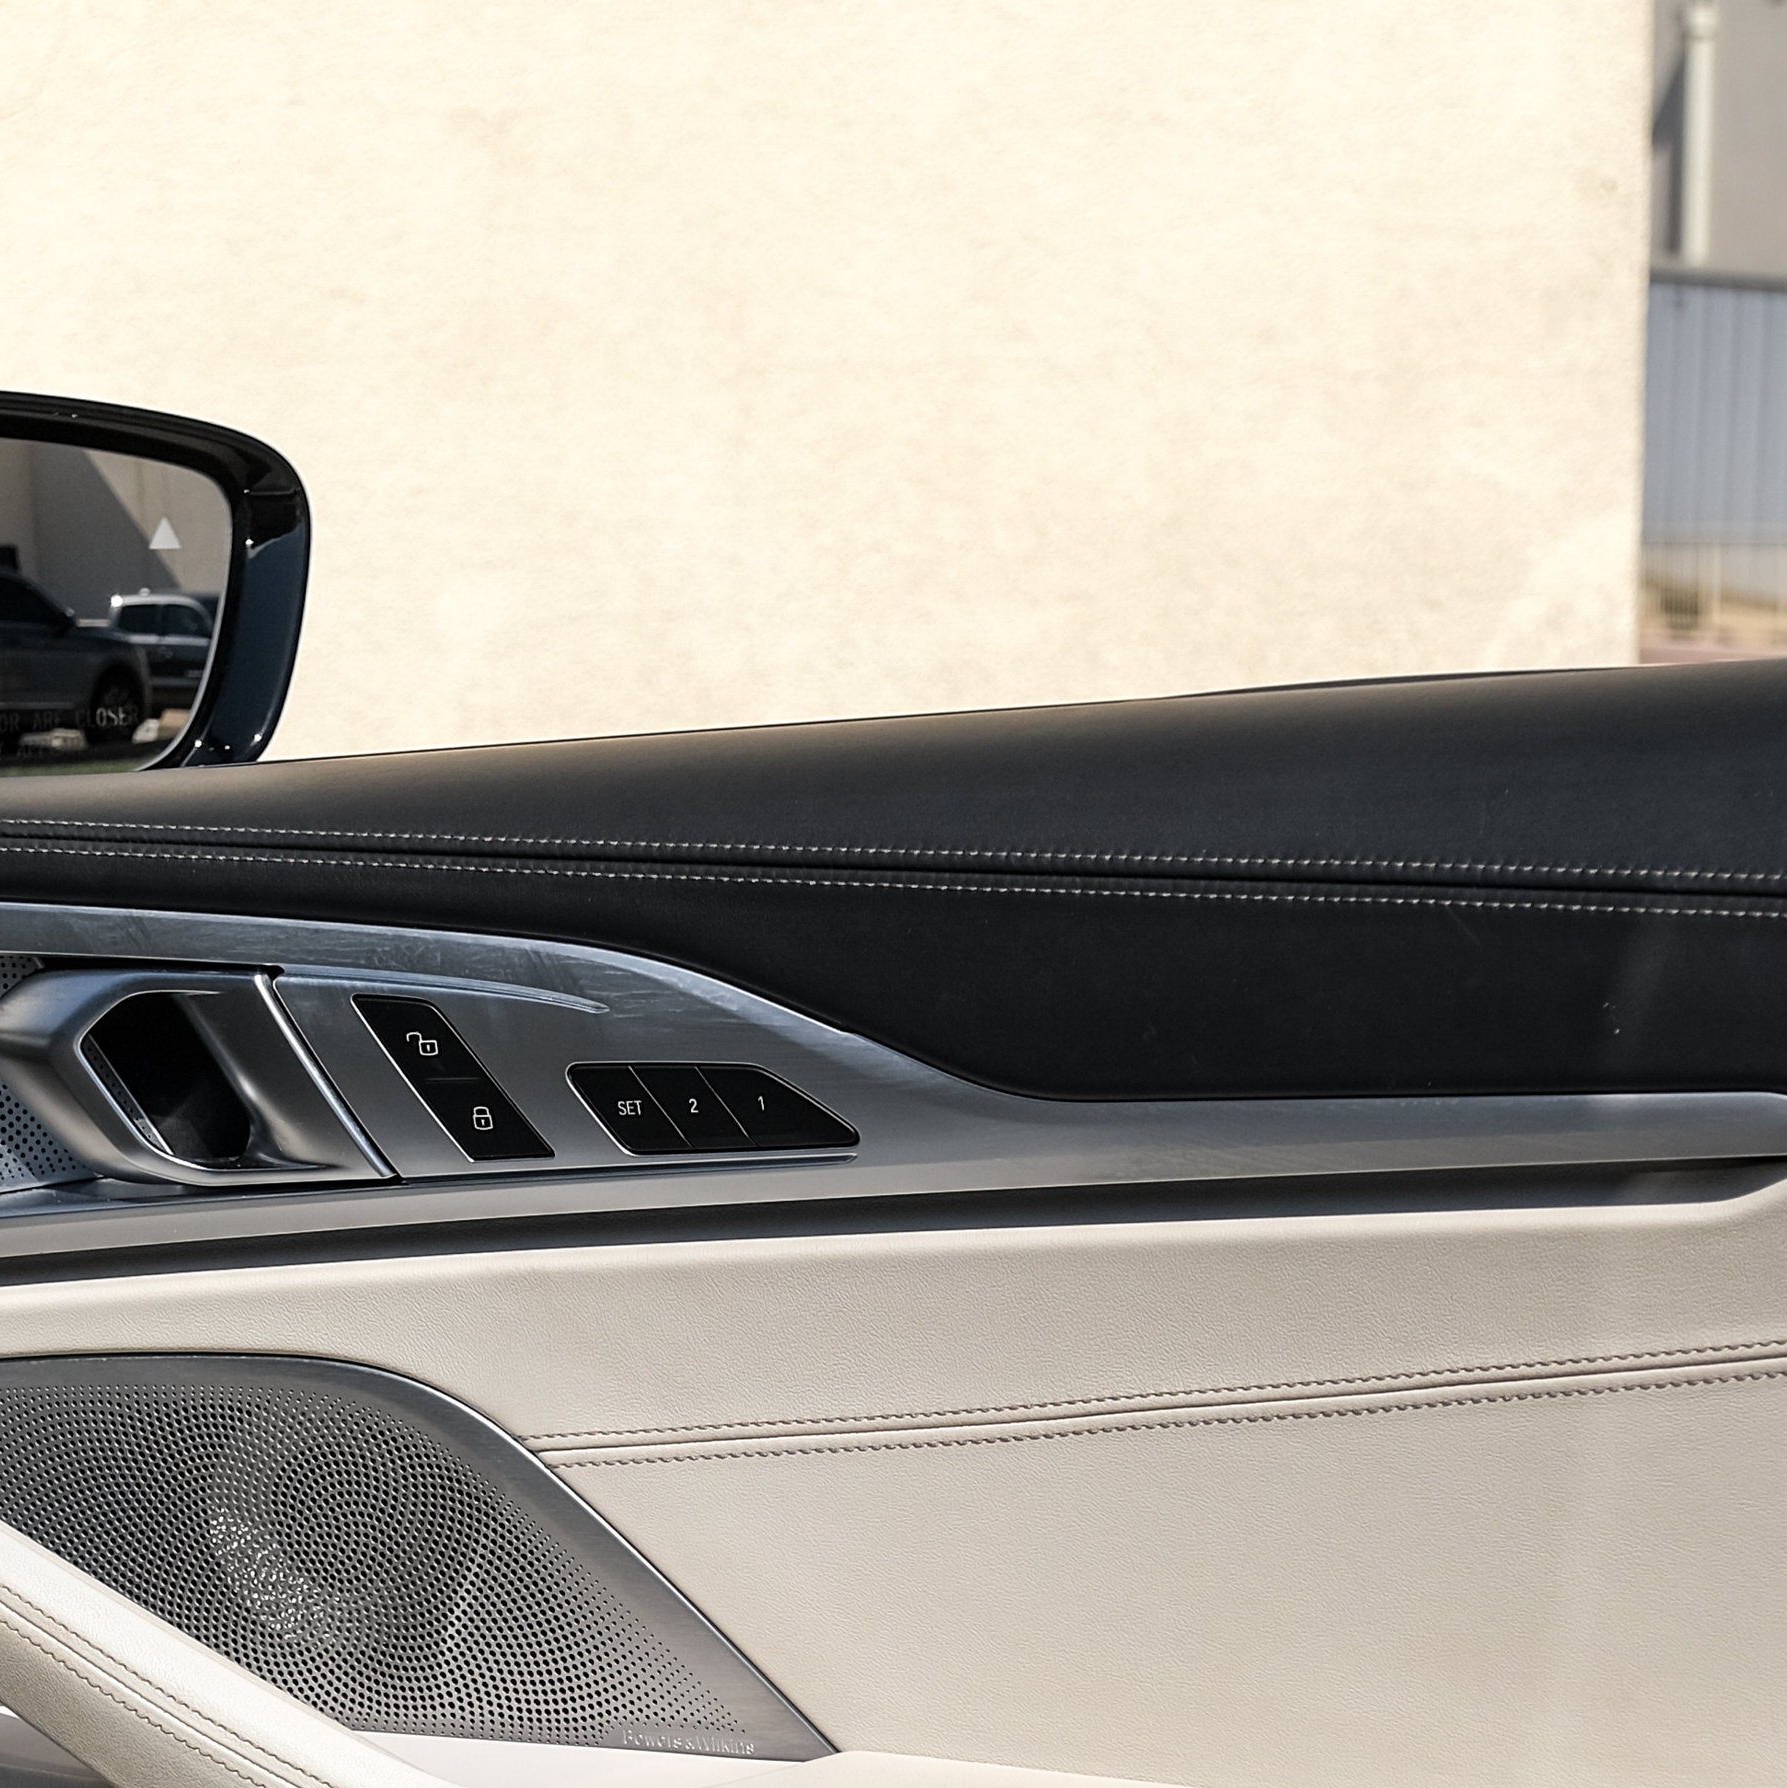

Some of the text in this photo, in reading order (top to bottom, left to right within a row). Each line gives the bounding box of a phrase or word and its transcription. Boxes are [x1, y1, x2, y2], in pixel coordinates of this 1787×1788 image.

[617, 1100, 642, 1116] SET
[688, 1098, 699, 1113] 2
[758, 1096, 765, 1111] 1
